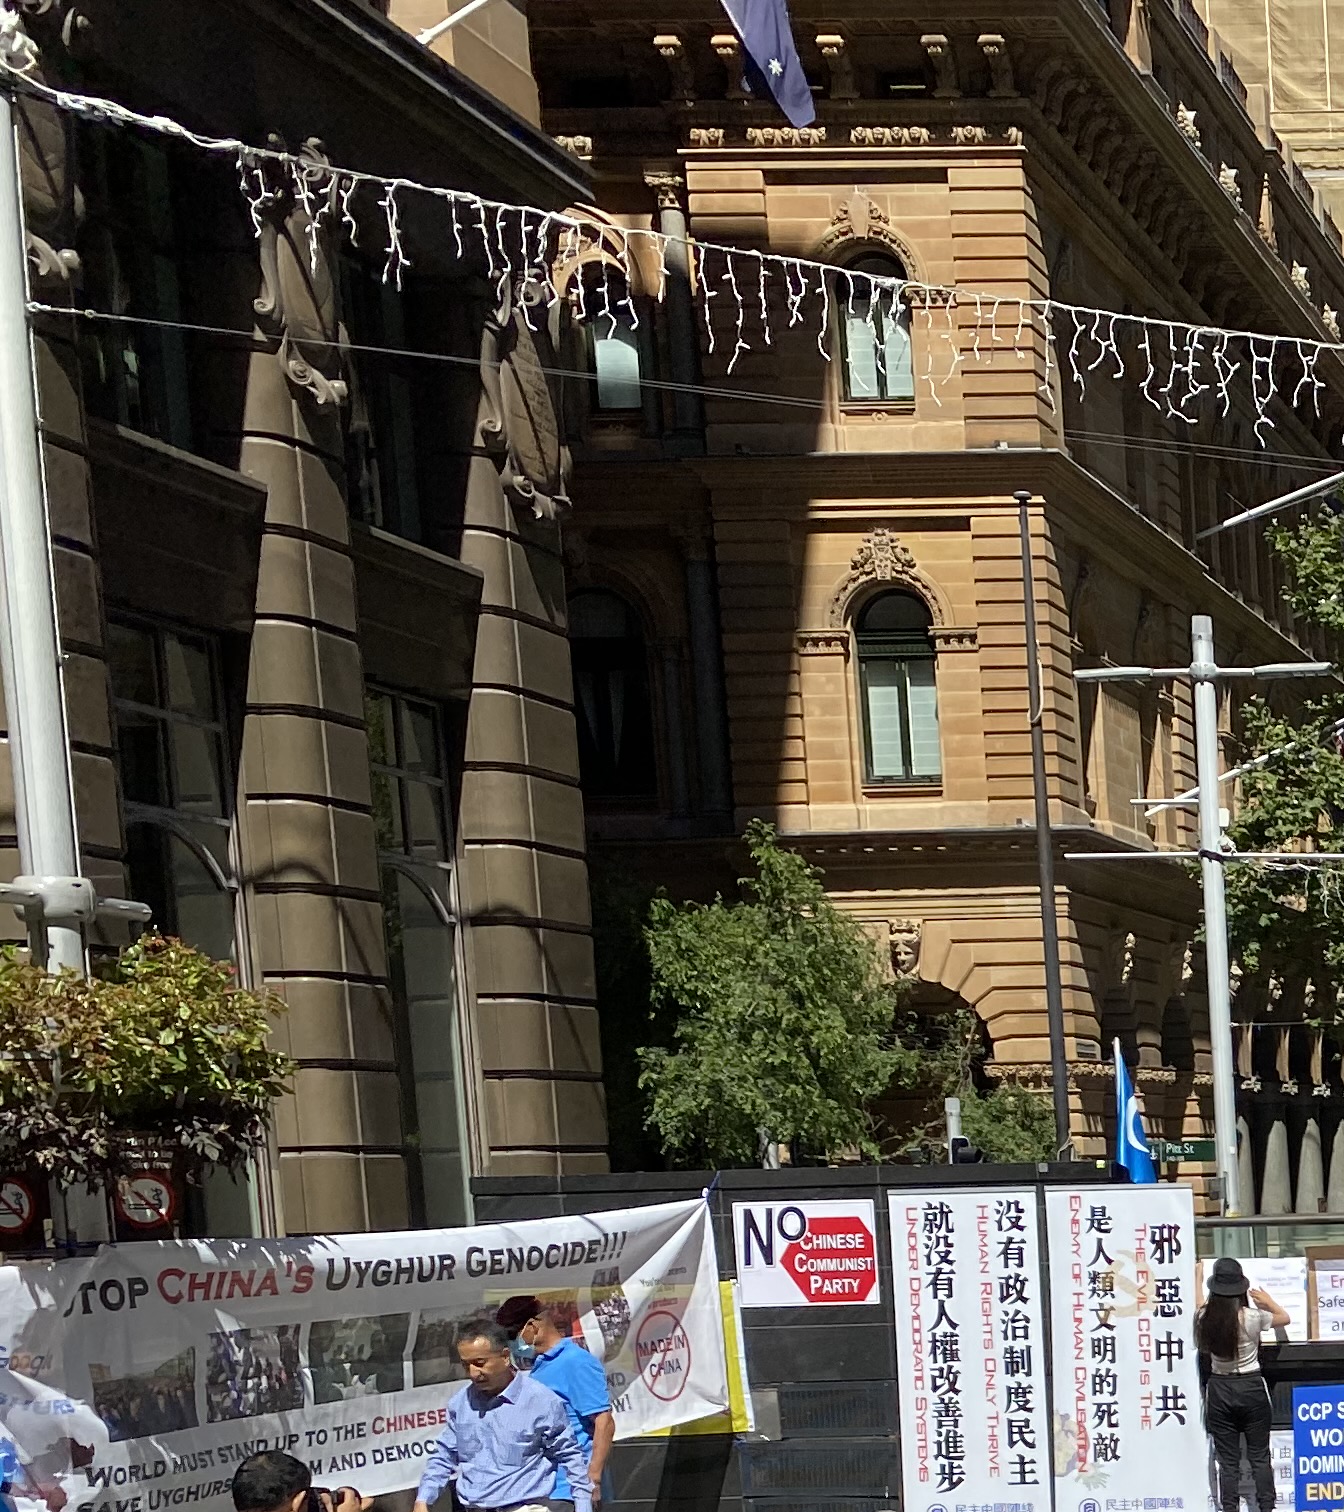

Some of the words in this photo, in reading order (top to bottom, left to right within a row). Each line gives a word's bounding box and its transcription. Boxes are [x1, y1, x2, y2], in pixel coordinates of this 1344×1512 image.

[157, 1261, 315, 1305] CHINA'S
[326, 1253, 456, 1291] UYGHUR
[466, 1231, 627, 1277] GENOCIDE!!!
[743, 1207, 806, 1268] NO
[793, 1253, 874, 1273] COMMUNIST
[800, 1232, 864, 1251] CHINESE
[976, 1205, 990, 1273] HUMAN
[810, 1275, 860, 1295] PARTY
[980, 1282, 994, 1350] RIGHTS
[909, 1277, 925, 1391] DEMOCRATIC
[1085, 1205, 1121, 1463] 是人類文明的死敵
[1149, 1223, 1187, 1426] 邪惡中共
[650, 1357, 682, 1378] CHINA
[1298, 1402, 1333, 1421] CCP
[85, 1460, 165, 1487] WORLD
[172, 1449, 215, 1474] MUST
[275, 1433, 299, 1452] UP
[305, 1428, 328, 1448] TO
[333, 1421, 366, 1443] THE
[372, 1409, 447, 1436] CHINESE
[148, 1481, 233, 1511] UYGHURS
[328, 1453, 368, 1474] AND
